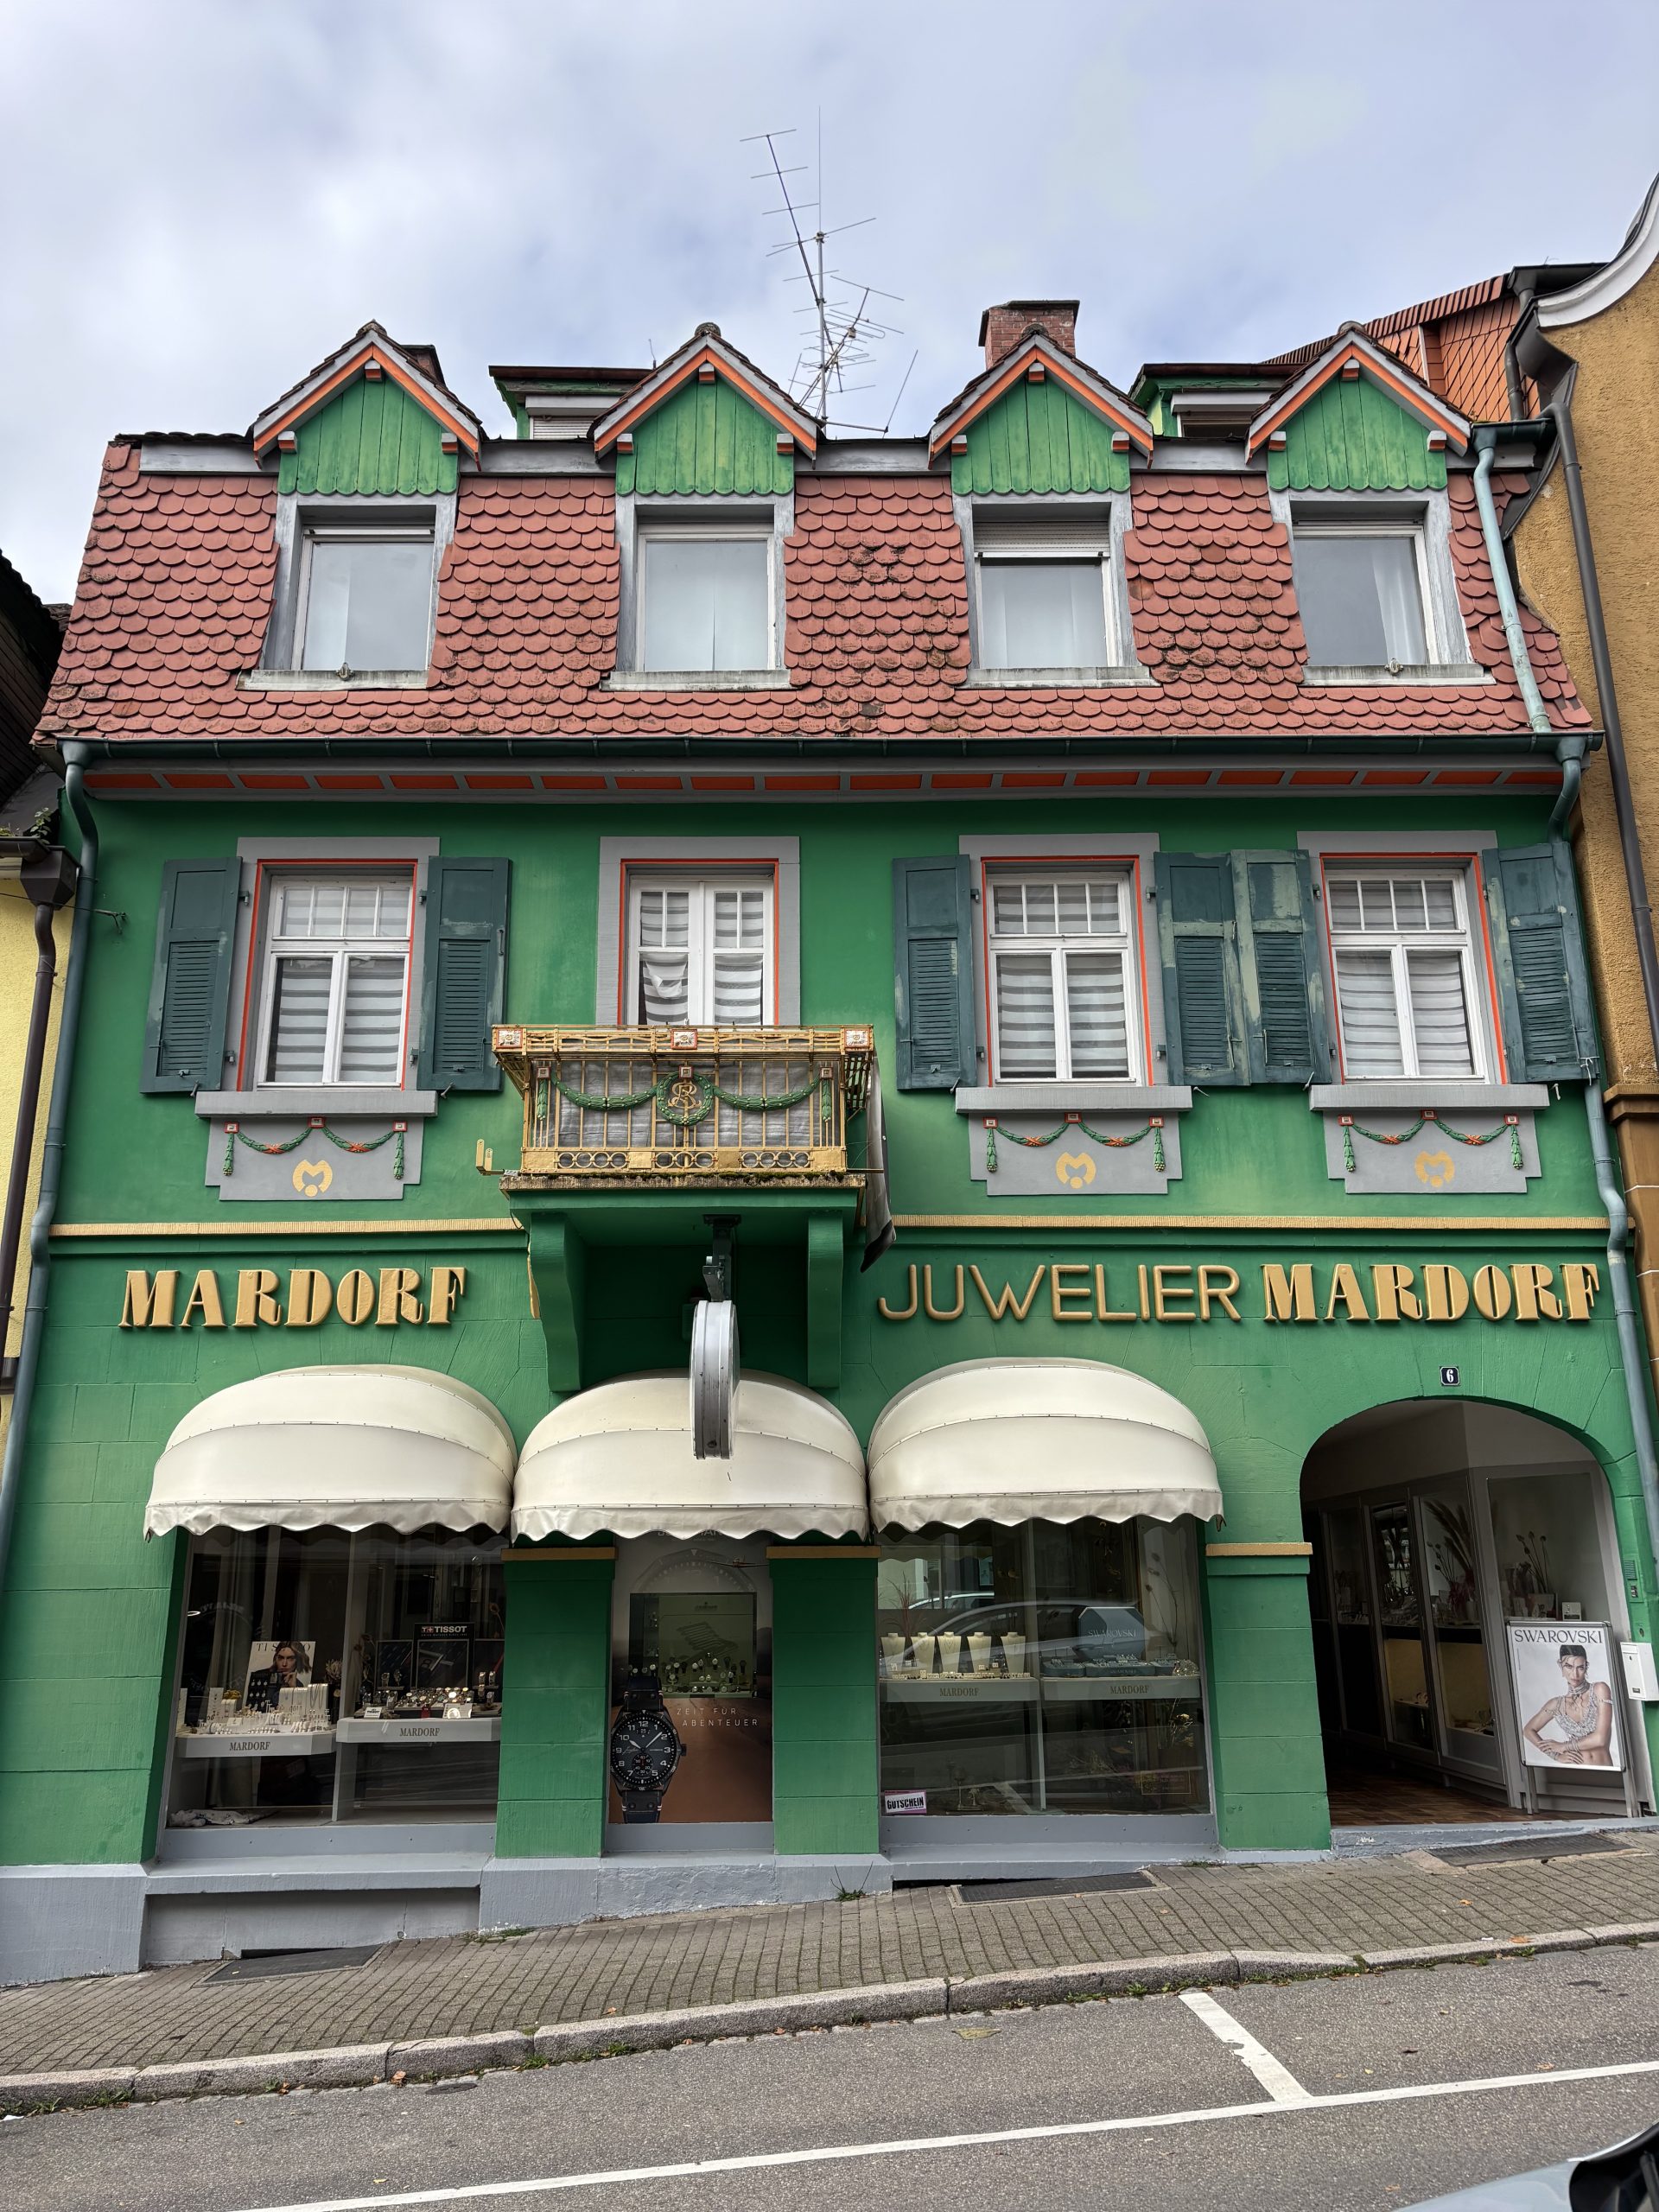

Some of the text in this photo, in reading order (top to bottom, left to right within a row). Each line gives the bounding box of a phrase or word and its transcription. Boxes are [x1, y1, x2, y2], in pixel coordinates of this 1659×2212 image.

[118, 1267, 467, 1328] MARDORF
[878, 1263, 1600, 1322] JUWELIER MARDORF
[1446, 1369, 1455, 1382] 6
[1089, 1630, 1137, 1638] SWAROVSKI
[1514, 1630, 1603, 1643] SWAROVSKI
[939, 1688, 980, 1697] MARDORF
[1109, 1685, 1149, 1694] MARDORF
[400, 1727, 440, 1737] MARDORF
[229, 1741, 270, 1751] MARDORF
[887, 1796, 925, 1809] GUTSCHEIN
